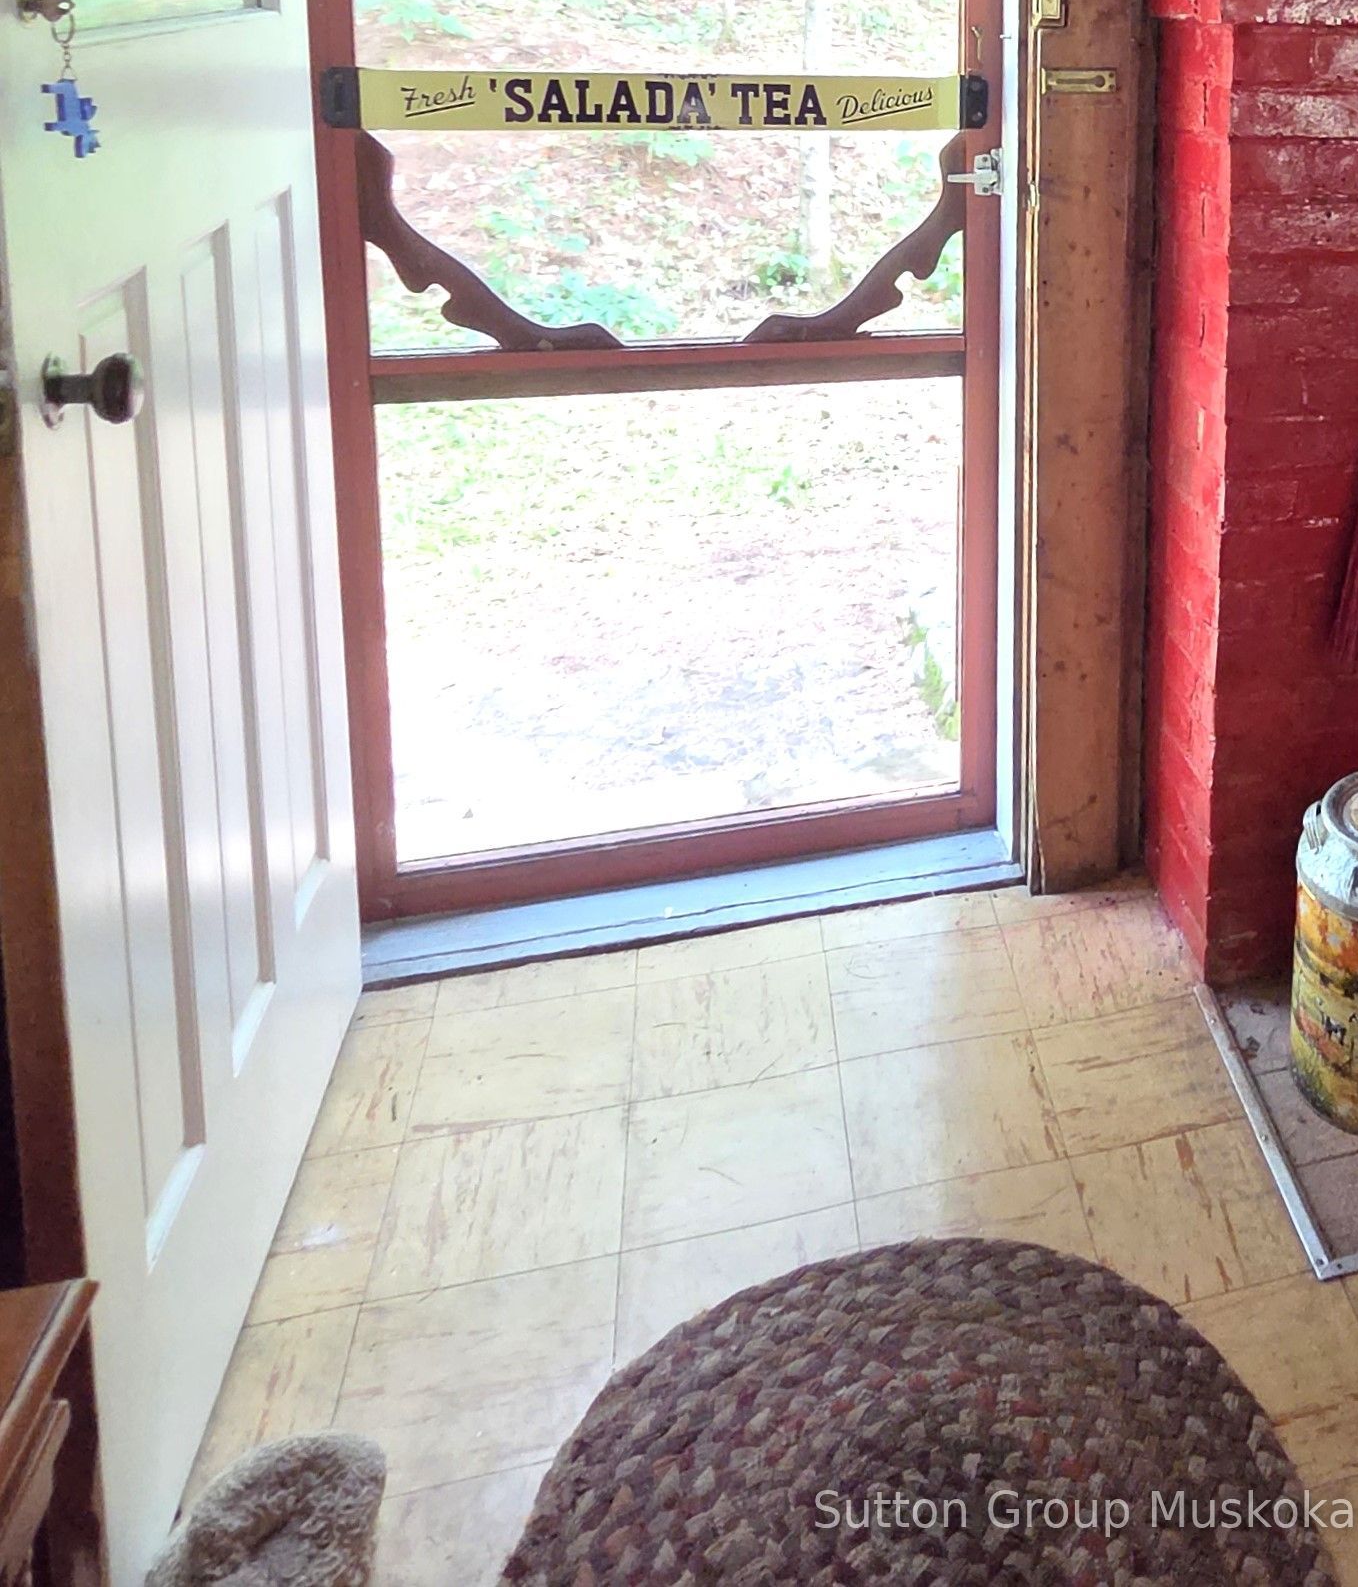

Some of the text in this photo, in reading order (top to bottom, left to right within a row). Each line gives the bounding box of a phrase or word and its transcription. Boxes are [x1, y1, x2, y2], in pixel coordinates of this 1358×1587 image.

[401, 76, 933, 126] Fresh 'SALADA' TEA Delicious
